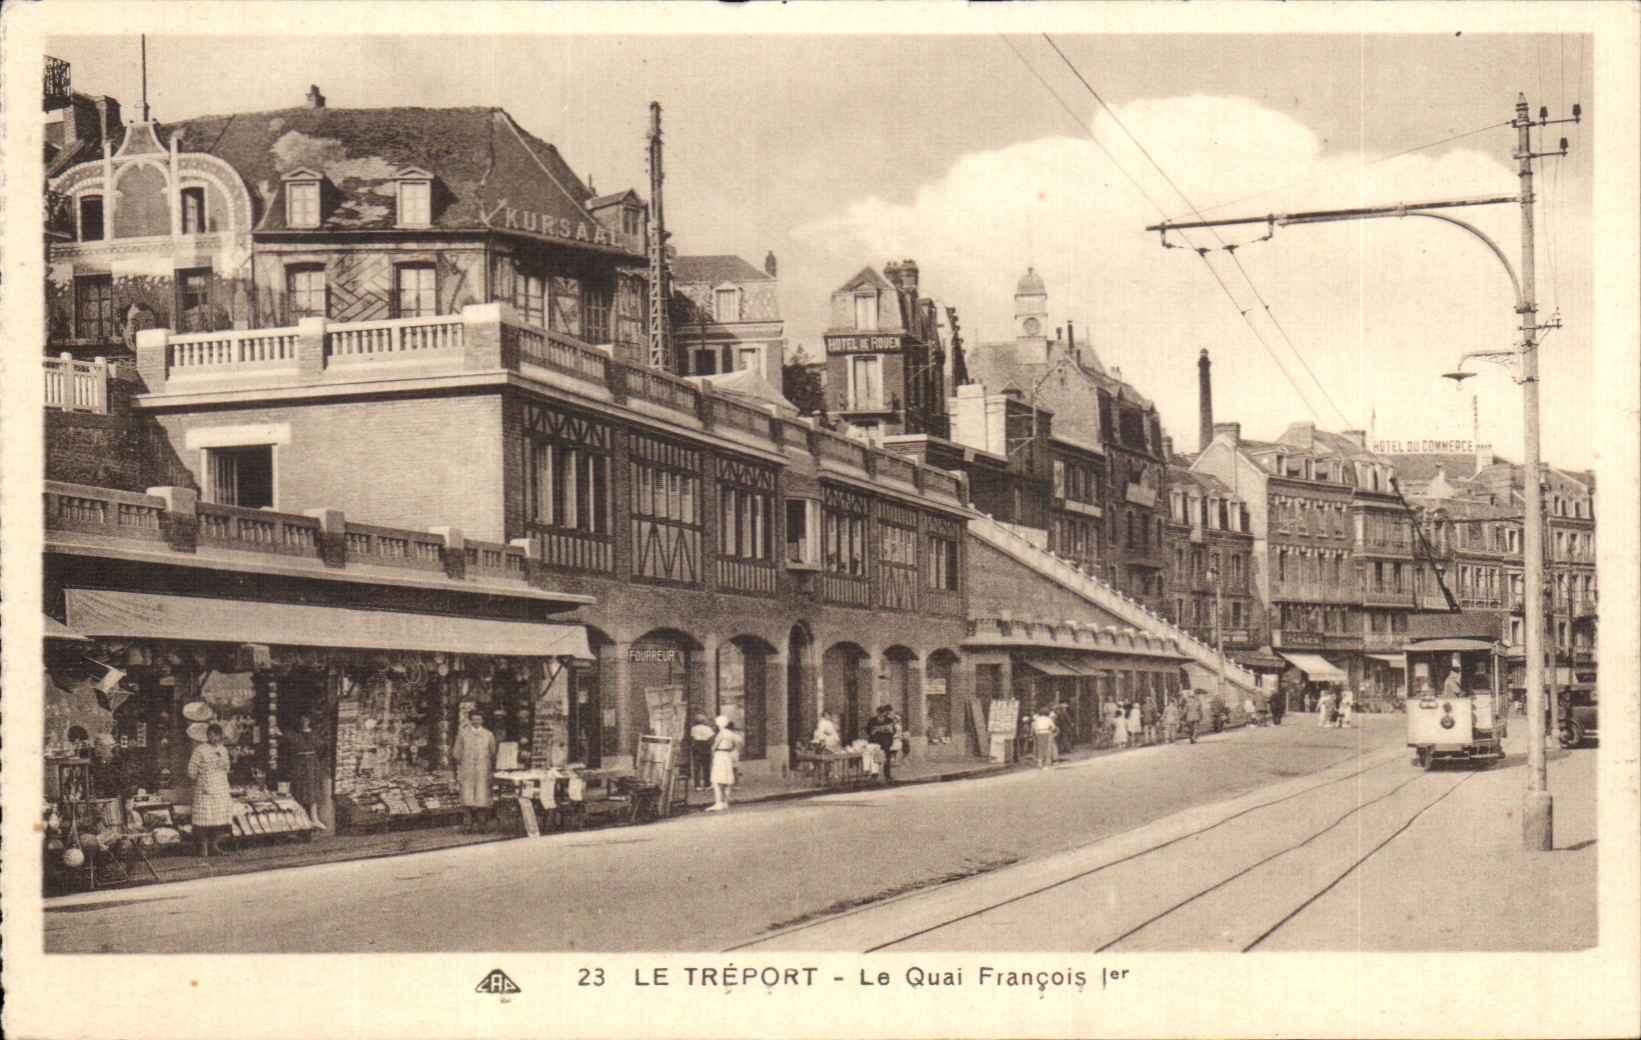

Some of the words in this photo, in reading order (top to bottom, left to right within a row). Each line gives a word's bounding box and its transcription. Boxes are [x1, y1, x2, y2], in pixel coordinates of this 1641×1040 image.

[505, 206, 623, 246] KURSAAL
[828, 337, 858, 352] HOTEL
[870, 335, 901, 351] ROUEN
[1373, 440, 1404, 453] HOTEL
[1407, 441, 1420, 452] DU
[1422, 440, 1473, 453] COMMERCE
[629, 649, 675, 662] FOURREUR
